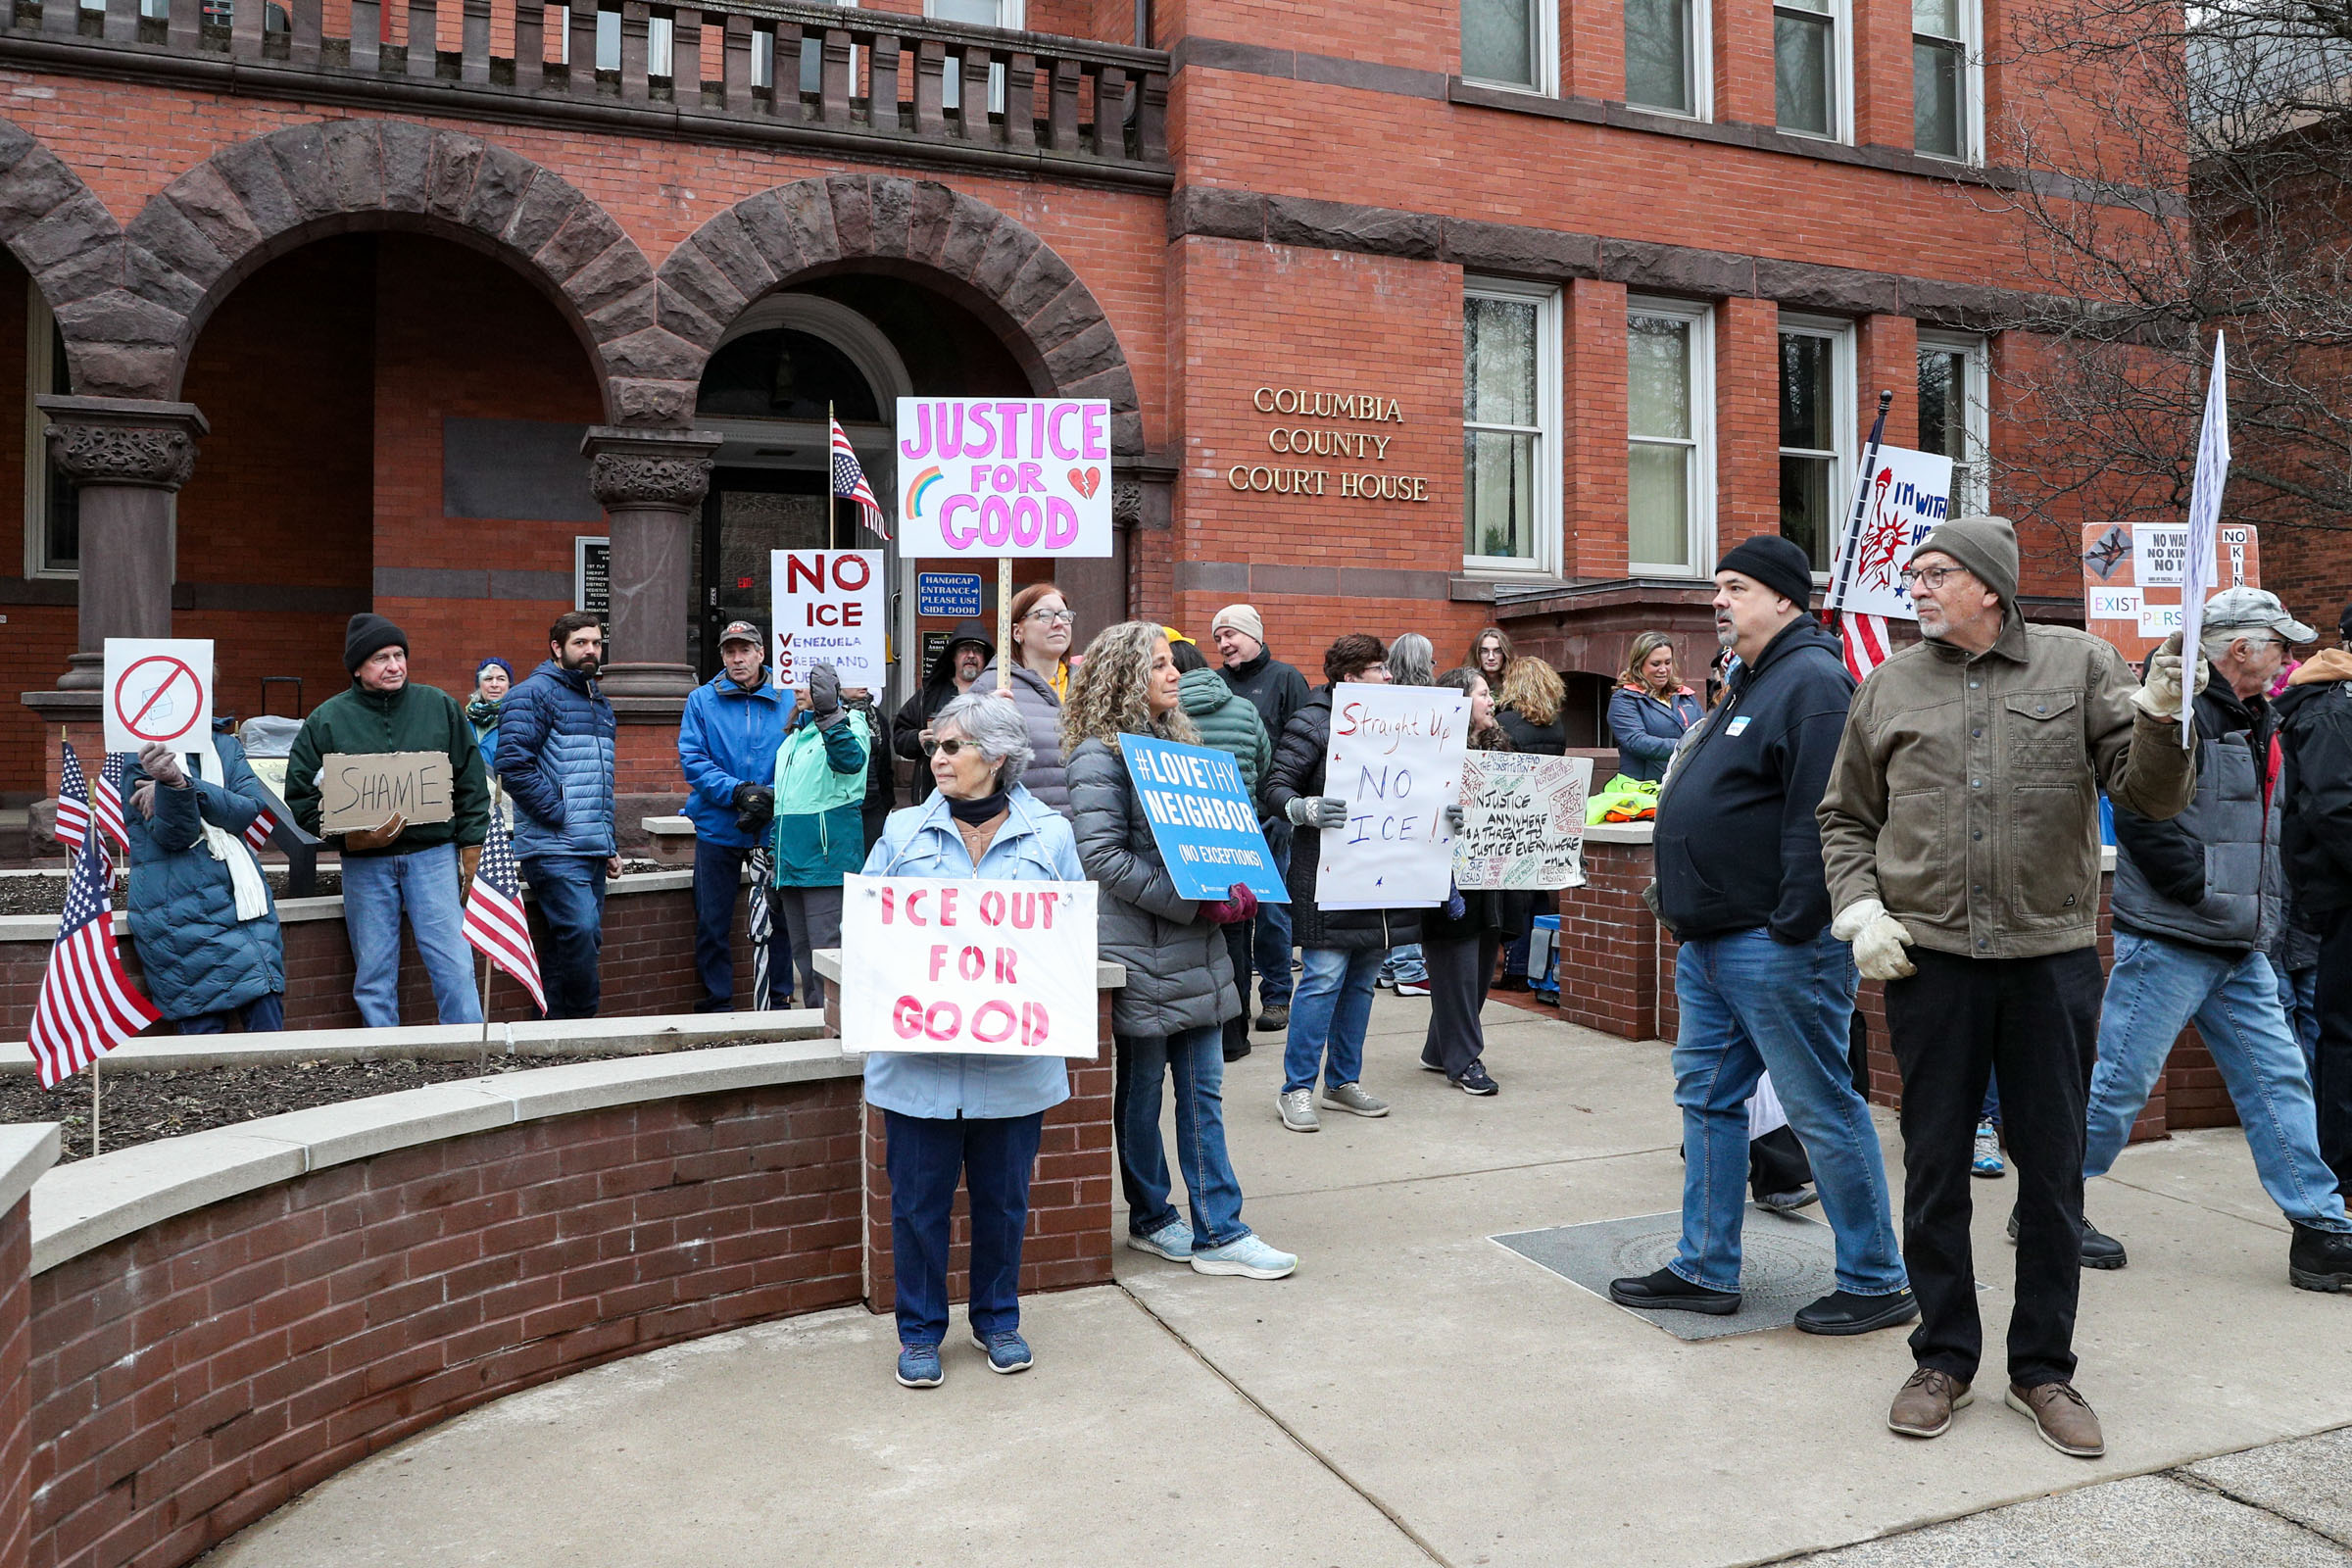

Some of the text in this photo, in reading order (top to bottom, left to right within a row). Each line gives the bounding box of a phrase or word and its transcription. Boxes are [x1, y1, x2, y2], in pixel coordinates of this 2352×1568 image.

[1253, 387, 1403, 422] COLUMBIA
[901, 402, 1106, 461] JUSTICE
[1268, 427, 1392, 460] COUNTY
[971, 463, 1047, 493] FOR
[1228, 465, 1429, 502] COURT HOUSE
[1893, 481, 1914, 506] I'M
[1916, 492, 1948, 519] WITH
[940, 494, 1078, 550] GOOD
[2153, 533, 2166, 547] NO
[2225, 531, 2245, 542] NO
[2147, 549, 2185, 558] NO KIN
[2155, 560, 2174, 571] NO
[787, 554, 870, 594] NO
[925, 576, 974, 585] HANDICAP
[921, 586, 970, 595] ENTRANCE
[807, 602, 862, 627] ICE
[2095, 597, 2140, 612] EXIST
[2143, 612, 2182, 626] PERS
[778, 633, 861, 648] VENEZUELA
[779, 651, 868, 668] GREENLAND
[780, 669, 812, 684] CUB
[1337, 702, 1451, 755] Straight Up
[331, 765, 442, 814] SHAME
[1356, 764, 1412, 804] NO
[1144, 789, 1259, 834] NEIGHBOR
[1473, 790, 1531, 809] INJUSTICE
[1488, 812, 1548, 829] ANYWHERE
[1483, 827, 1525, 842] THREAT
[1526, 828, 1543, 841] TO
[1178, 844, 1264, 870] (NO EXCEPTIONS)
[1468, 837, 1580, 859] JUSTICE EVERYWHERE
[882, 886, 1058, 929] ICE OUT
[928, 944, 1018, 984] FOR
[893, 995, 1050, 1047] GOOD
